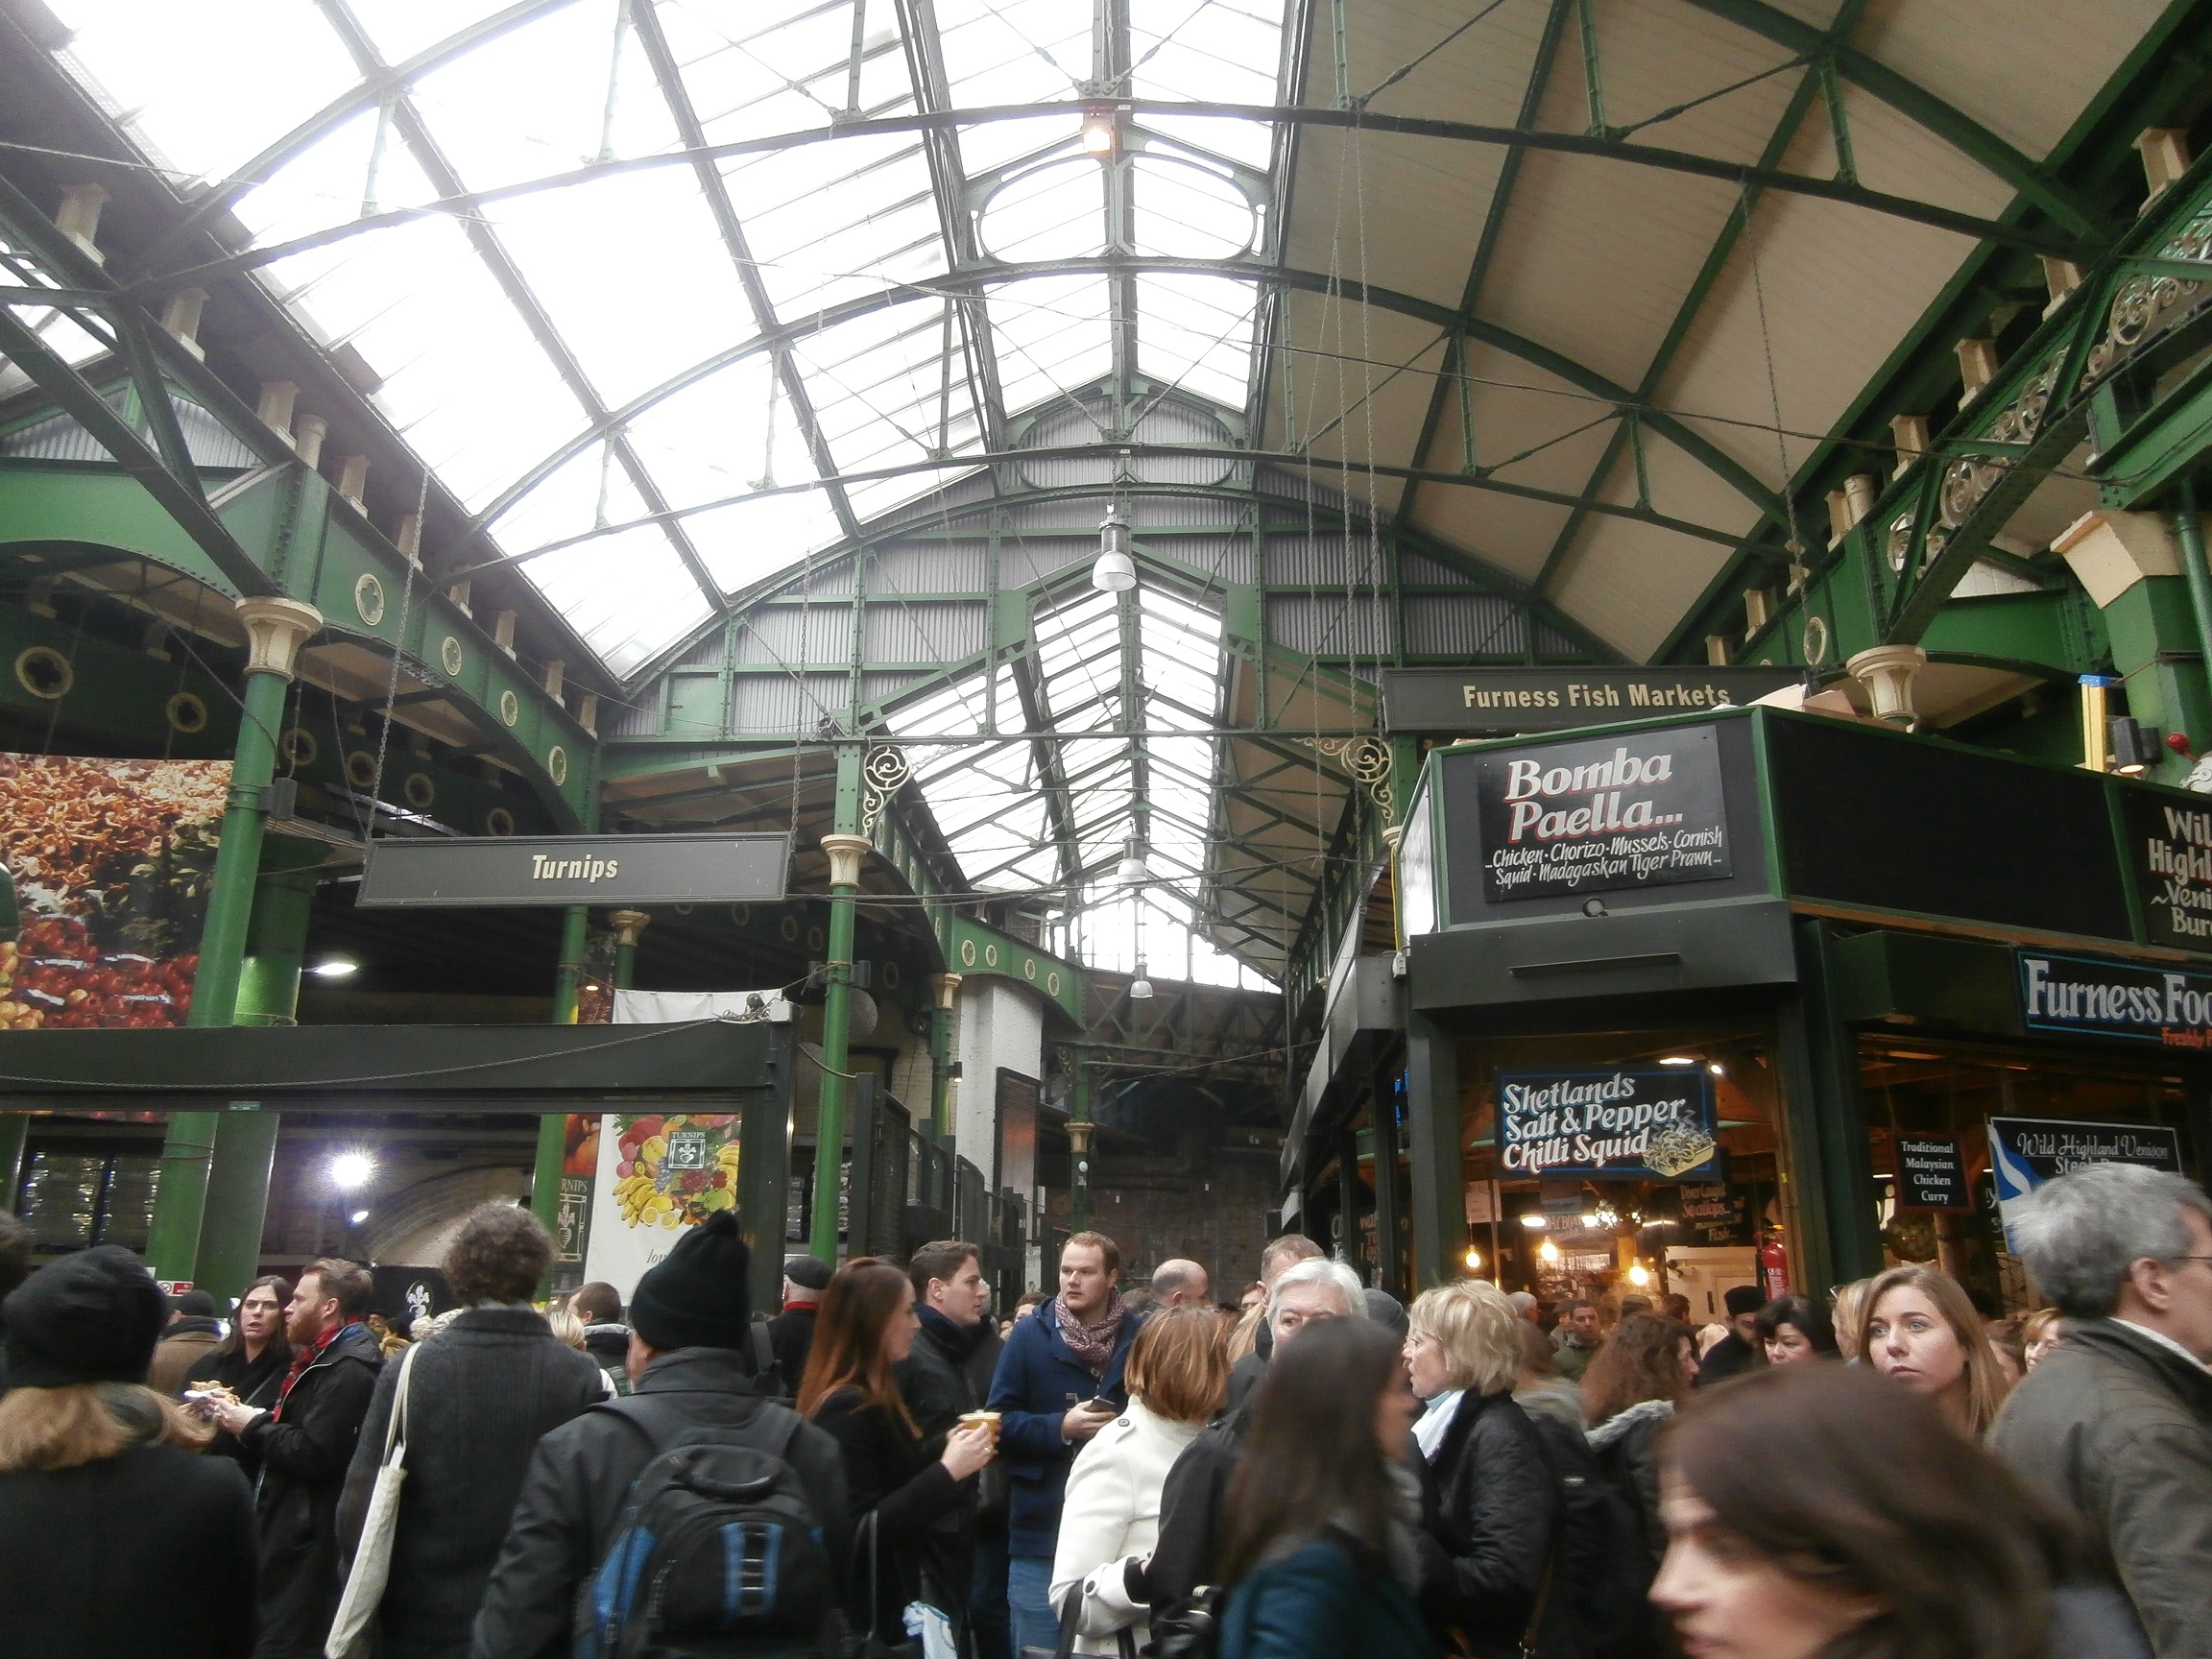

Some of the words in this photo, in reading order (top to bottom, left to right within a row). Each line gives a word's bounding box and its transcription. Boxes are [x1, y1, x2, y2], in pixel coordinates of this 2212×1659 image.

[1463, 685, 1560, 708] Furness
[1568, 685, 1620, 707] Fish
[1628, 684, 1731, 707] Markets
[1503, 748, 1672, 801] Bomba
[1673, 826, 1722, 849] Cornish
[533, 854, 618, 882] Turnips
[1539, 857, 1627, 887] Madagaskan
[1630, 854, 1670, 879] Tiger
[2171, 906, 2212, 937] Bur
[2024, 959, 2162, 1023] Furness
[1503, 1072, 1636, 1114] Shetlands
[1505, 1111, 1559, 1142] Salt
[1560, 1106, 1582, 1134] &
[1584, 1098, 1687, 1133] Pepper
[672, 1131, 706, 1140] TURNIPS
[1503, 1137, 1570, 1173] Chilli
[1575, 1126, 1650, 1168] Squid
[1901, 1141, 1955, 1154] Traditional
[2017, 1132, 2056, 1155] Wild
[2057, 1134, 2119, 1161] Highland
[1906, 1157, 1955, 1171] Malaysian
[1913, 1173, 1951, 1186] Chicken
[1921, 1190, 1949, 1204] Curry
